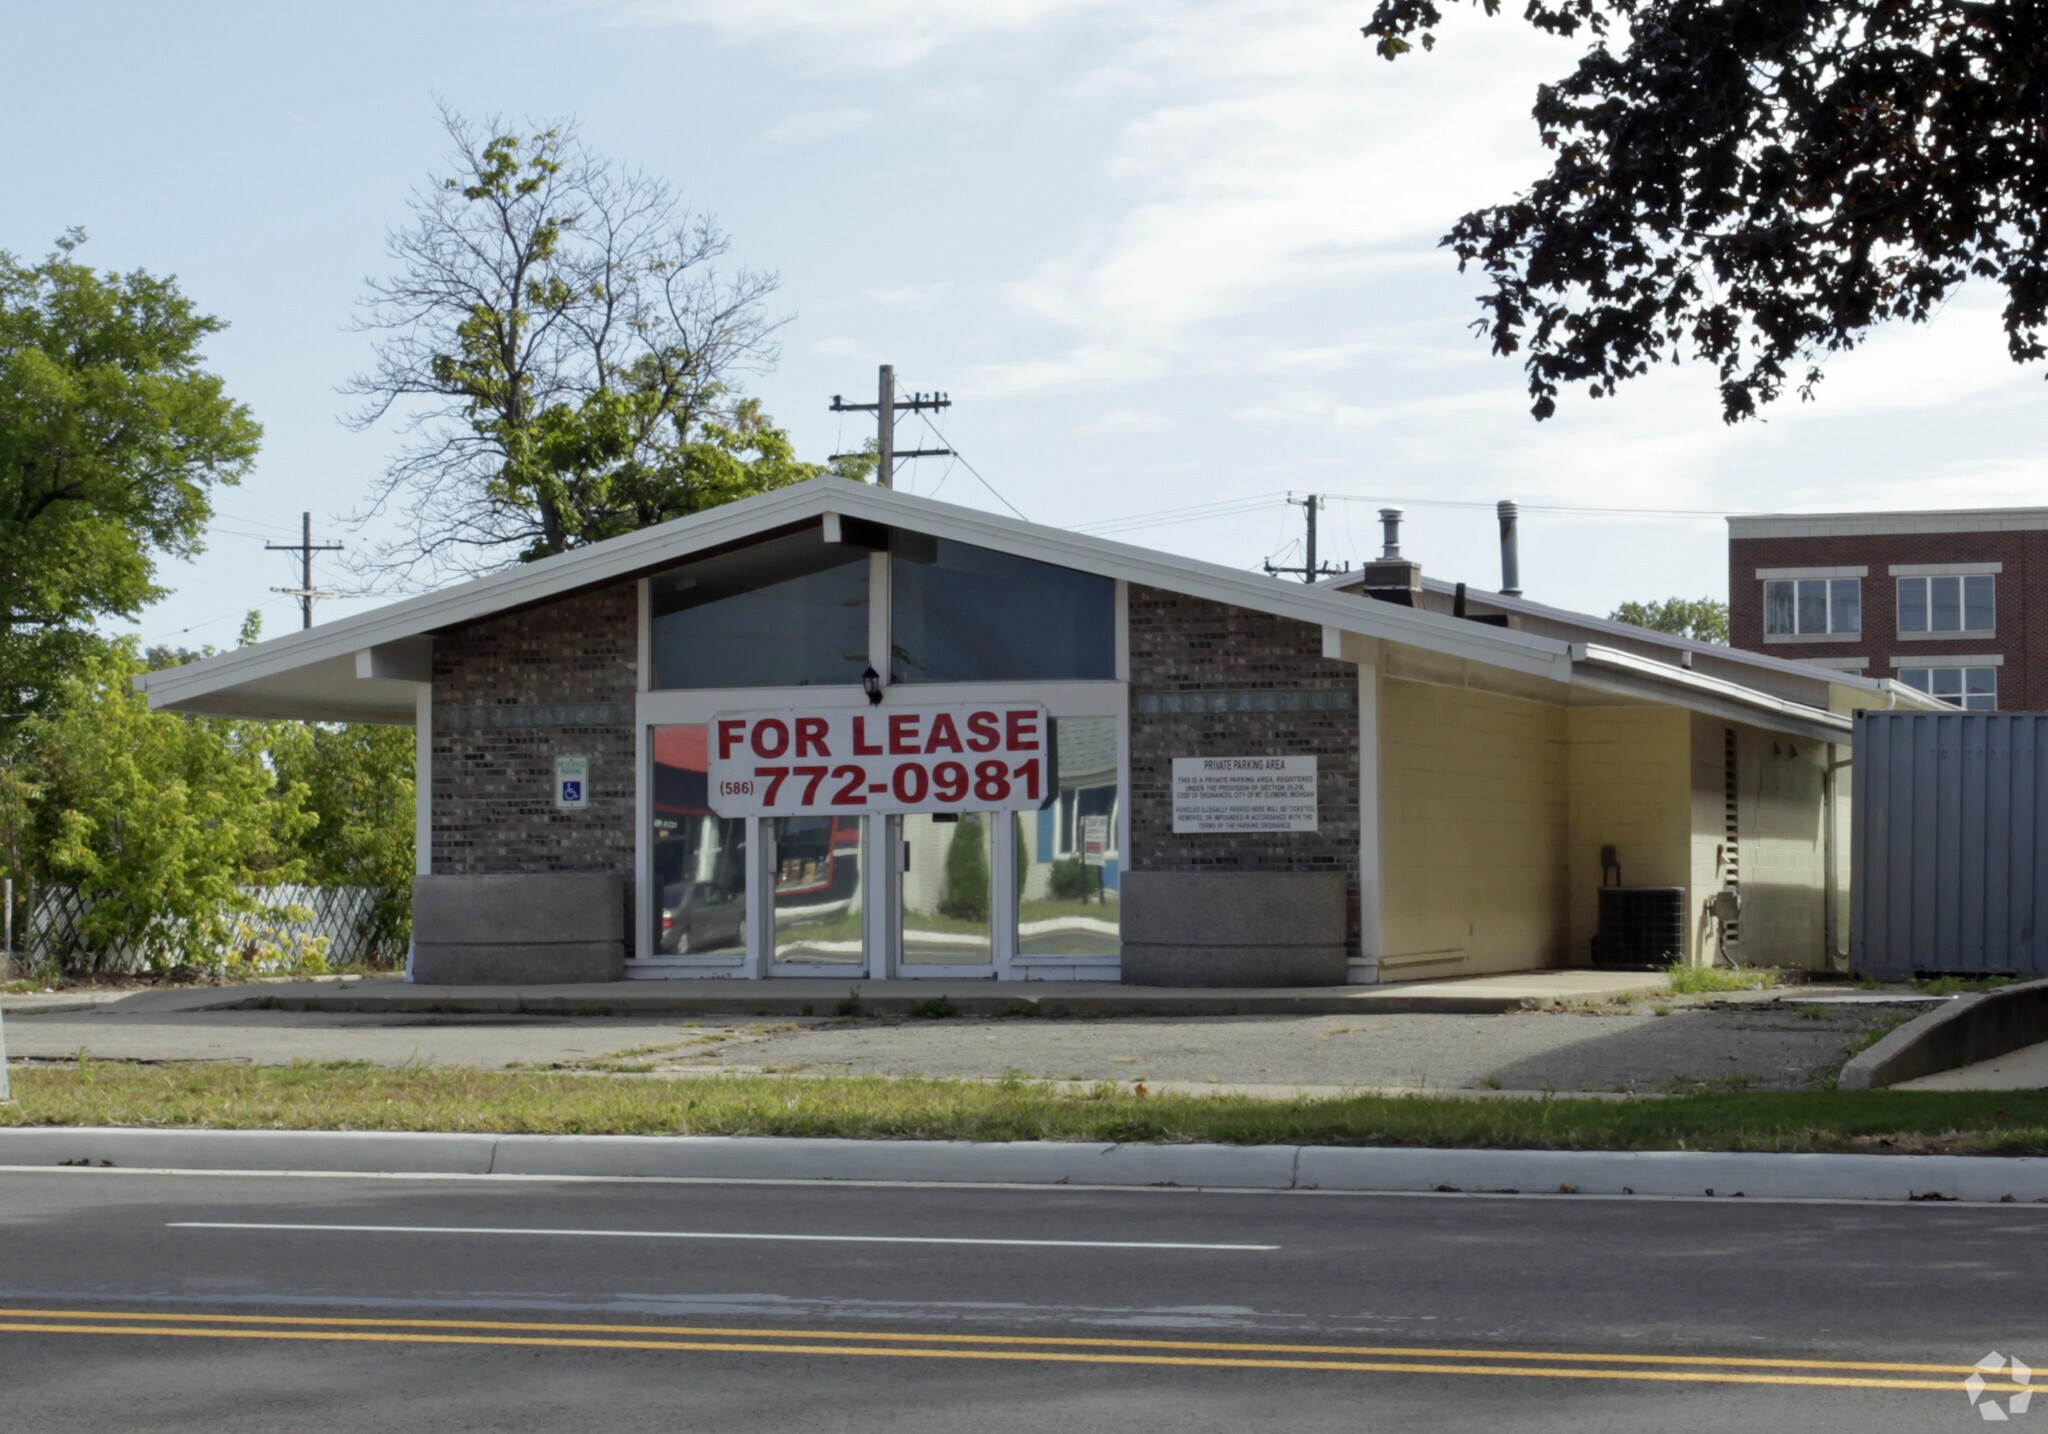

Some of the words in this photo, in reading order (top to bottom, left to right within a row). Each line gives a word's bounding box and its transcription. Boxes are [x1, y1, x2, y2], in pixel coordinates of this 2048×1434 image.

[718, 717, 831, 759] FOR
[852, 710, 1039, 756] LEASE
[720, 780, 754, 796] (586)
[754, 759, 1039, 806] 772-0981
[1204, 760, 1232, 771] PRIVATE
[1233, 760, 1264, 770] PARKING
[1265, 759, 1286, 770] AREA
